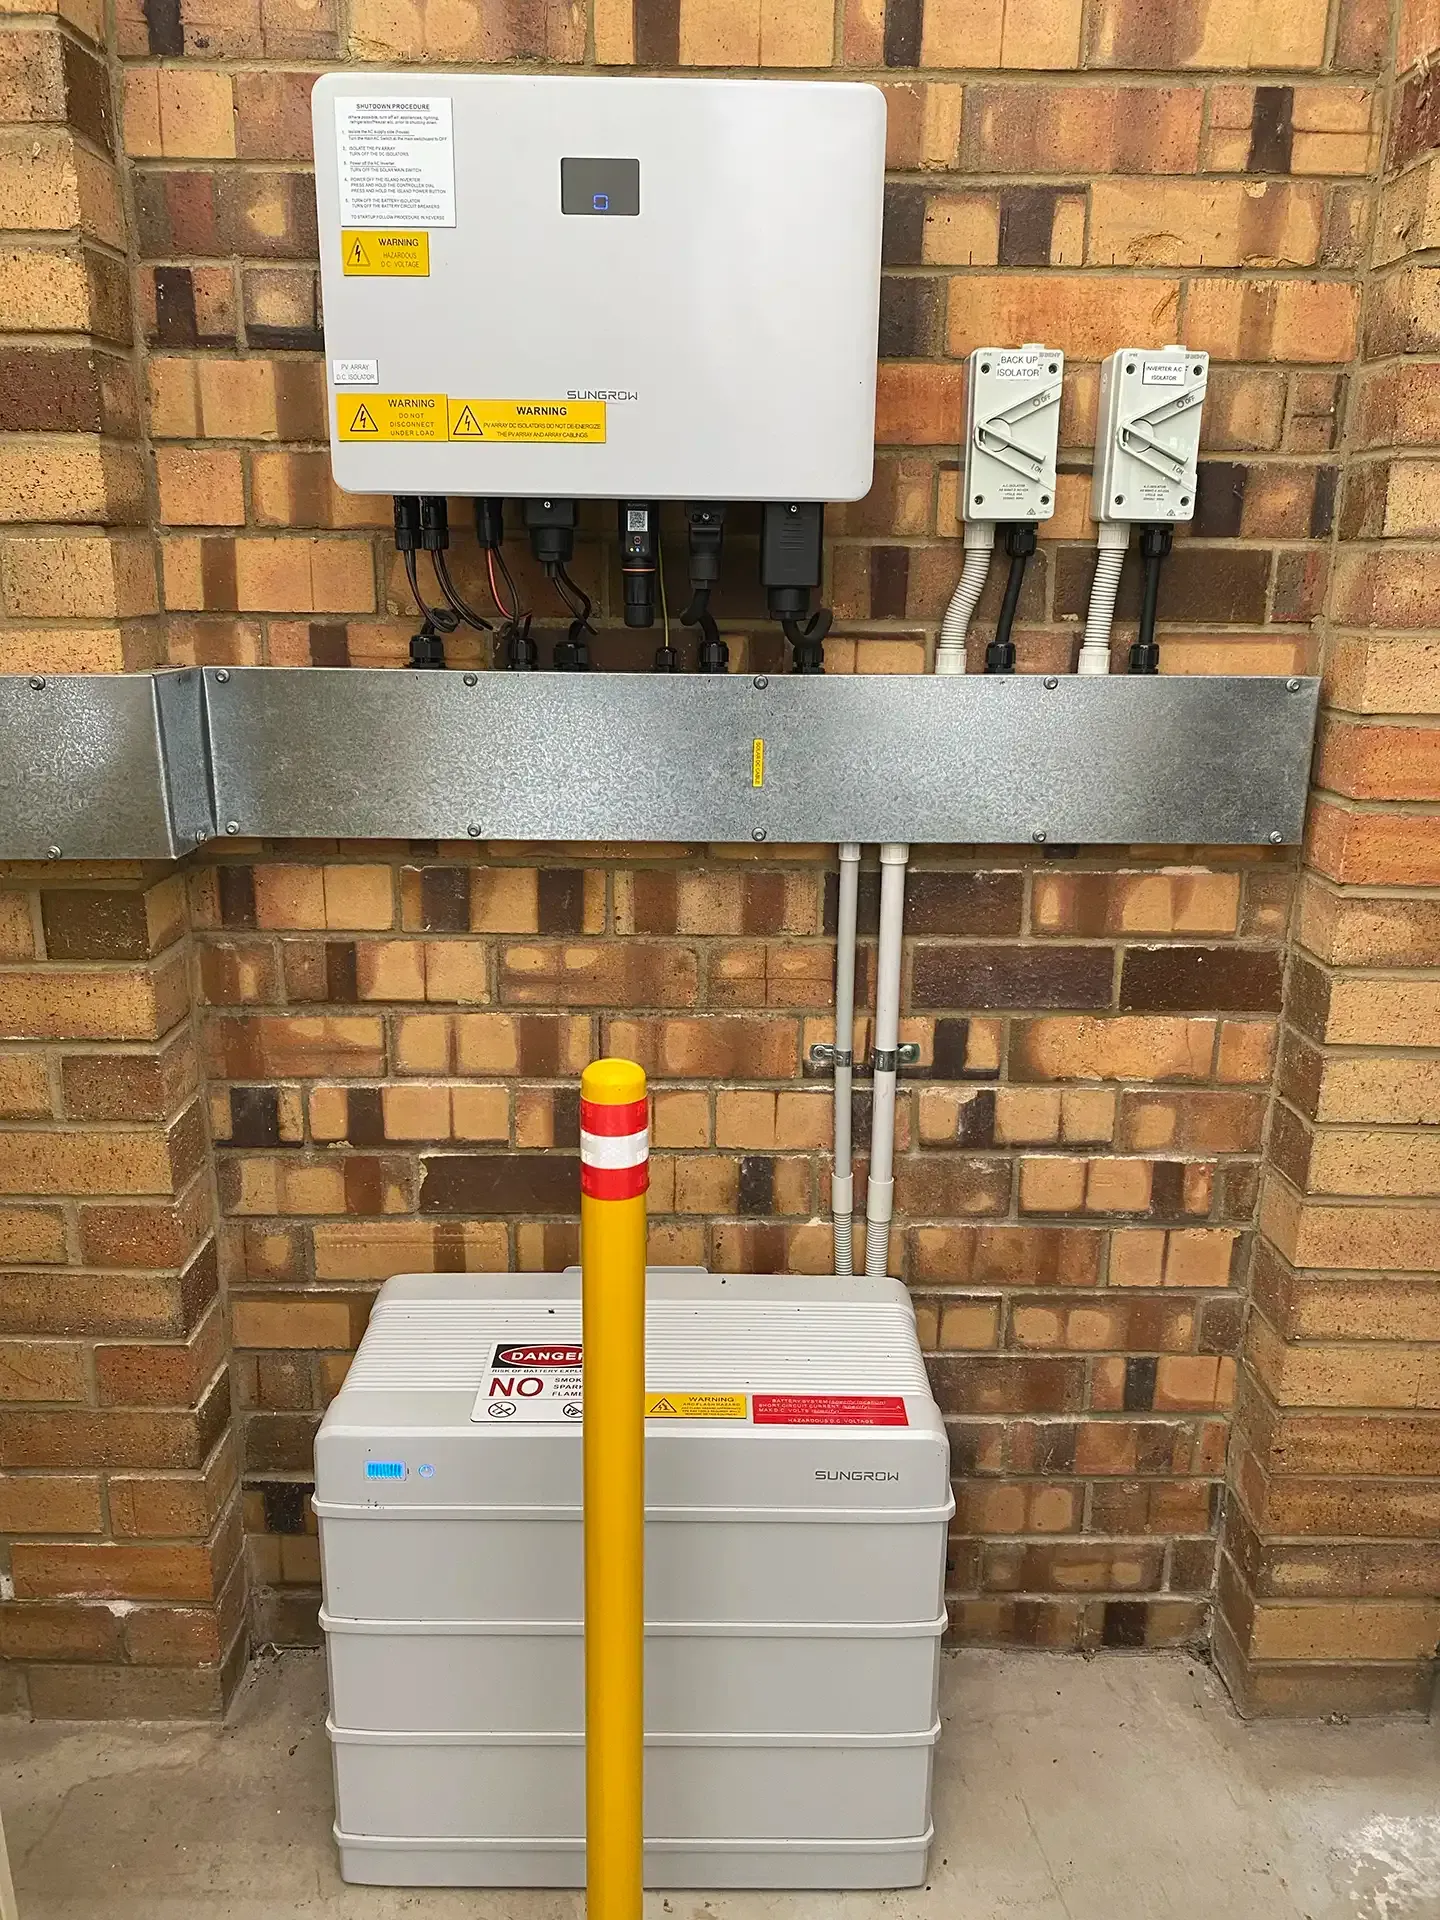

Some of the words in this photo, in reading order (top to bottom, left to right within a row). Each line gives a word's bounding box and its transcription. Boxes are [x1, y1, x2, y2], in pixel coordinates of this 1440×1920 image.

[378, 238, 419, 246] WARNING
[1000, 356, 1024, 364] BACK
[1026, 356, 1039, 364] UP
[566, 391, 638, 400] SUNGROW
[1041, 393, 1051, 402] OFF
[1185, 395, 1196, 404] OFF
[388, 399, 435, 408] WARNING
[516, 407, 567, 416] WARNING
[488, 1377, 544, 1397] NO
[815, 1471, 899, 1480] SUNGROW
